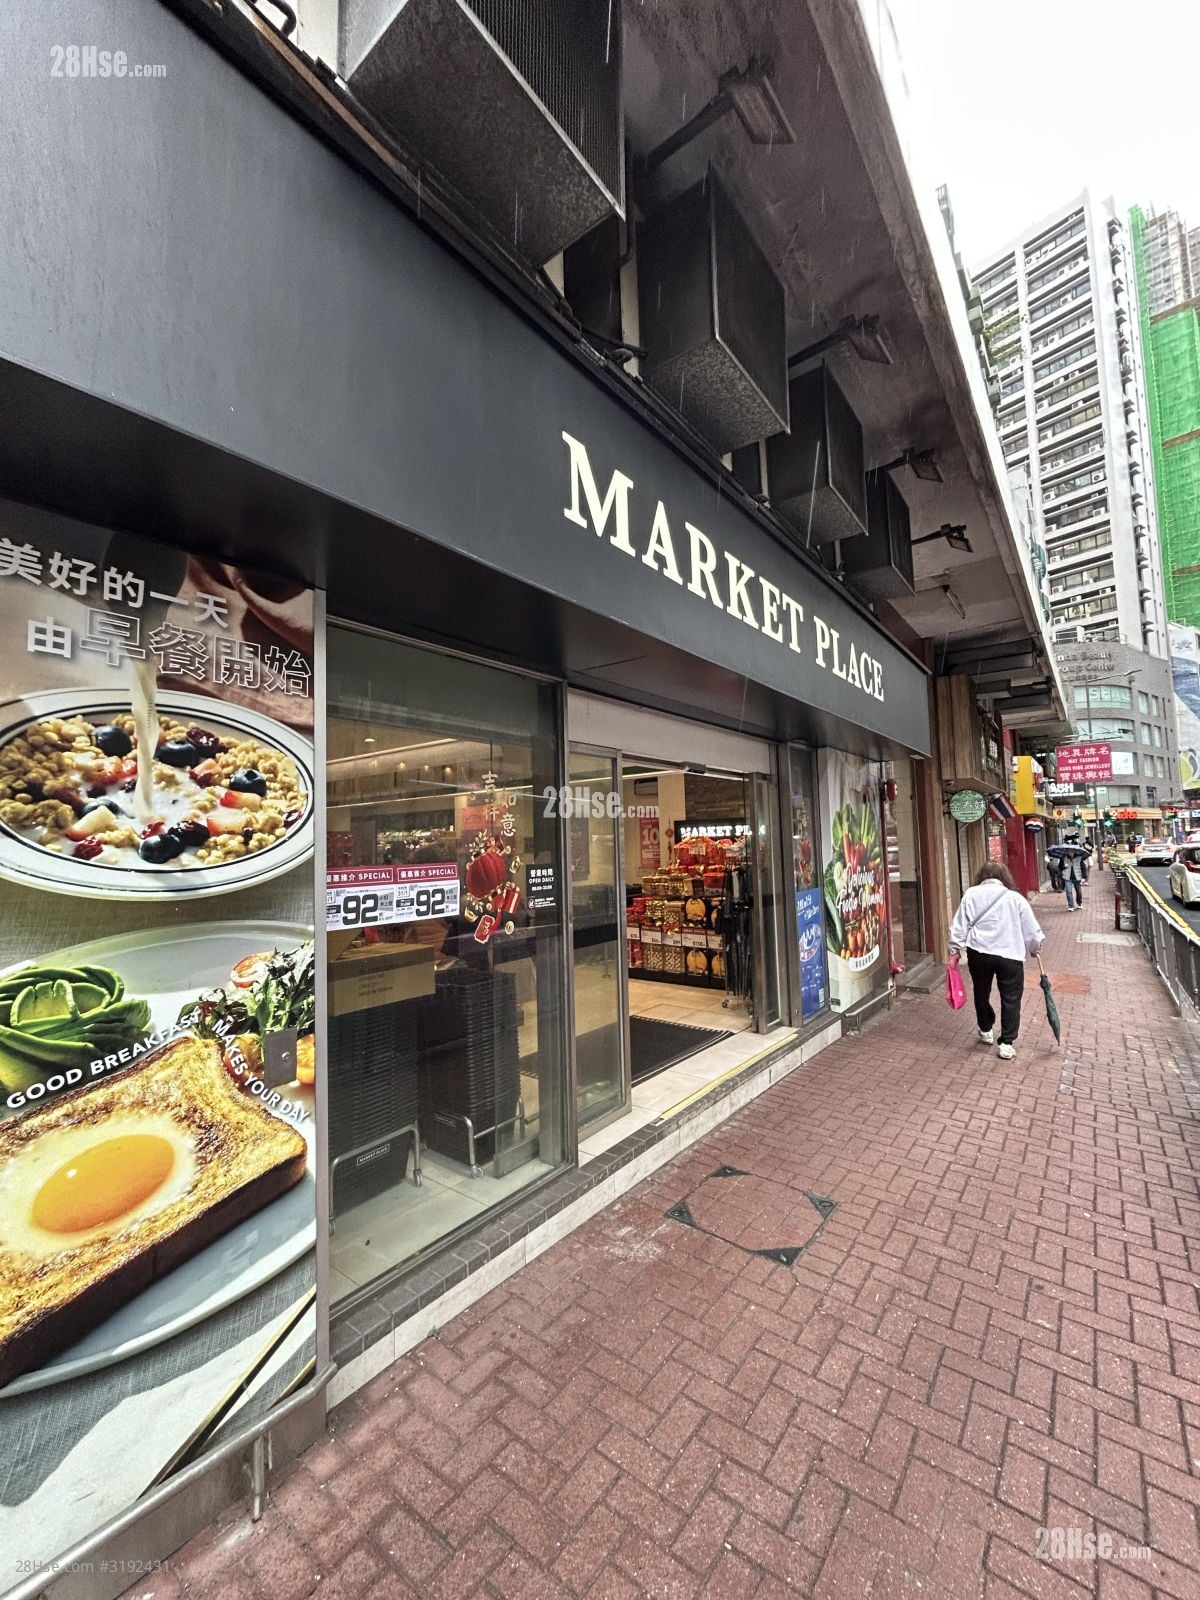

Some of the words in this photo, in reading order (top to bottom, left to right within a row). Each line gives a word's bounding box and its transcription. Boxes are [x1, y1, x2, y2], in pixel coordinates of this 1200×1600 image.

[0, 538, 229, 629] 美好的一天
[562, 431, 804, 654] MARKET
[813, 616, 885, 702] PLACE
[27, 607, 312, 698] 由早餐開始
[680, 825, 732, 838] MARKET
[358, 871, 391, 880] SPECIAL
[415, 888, 445, 917] 92
[428, 868, 455, 876] SPECIAL
[342, 894, 379, 925] 92
[7, 1067, 83, 1109] GOOD
[90, 1006, 203, 1074] BREAKFAST
[212, 1017, 249, 1075] MAKES
[243, 1072, 282, 1110] YOUR
[279, 1099, 310, 1125] DAY
